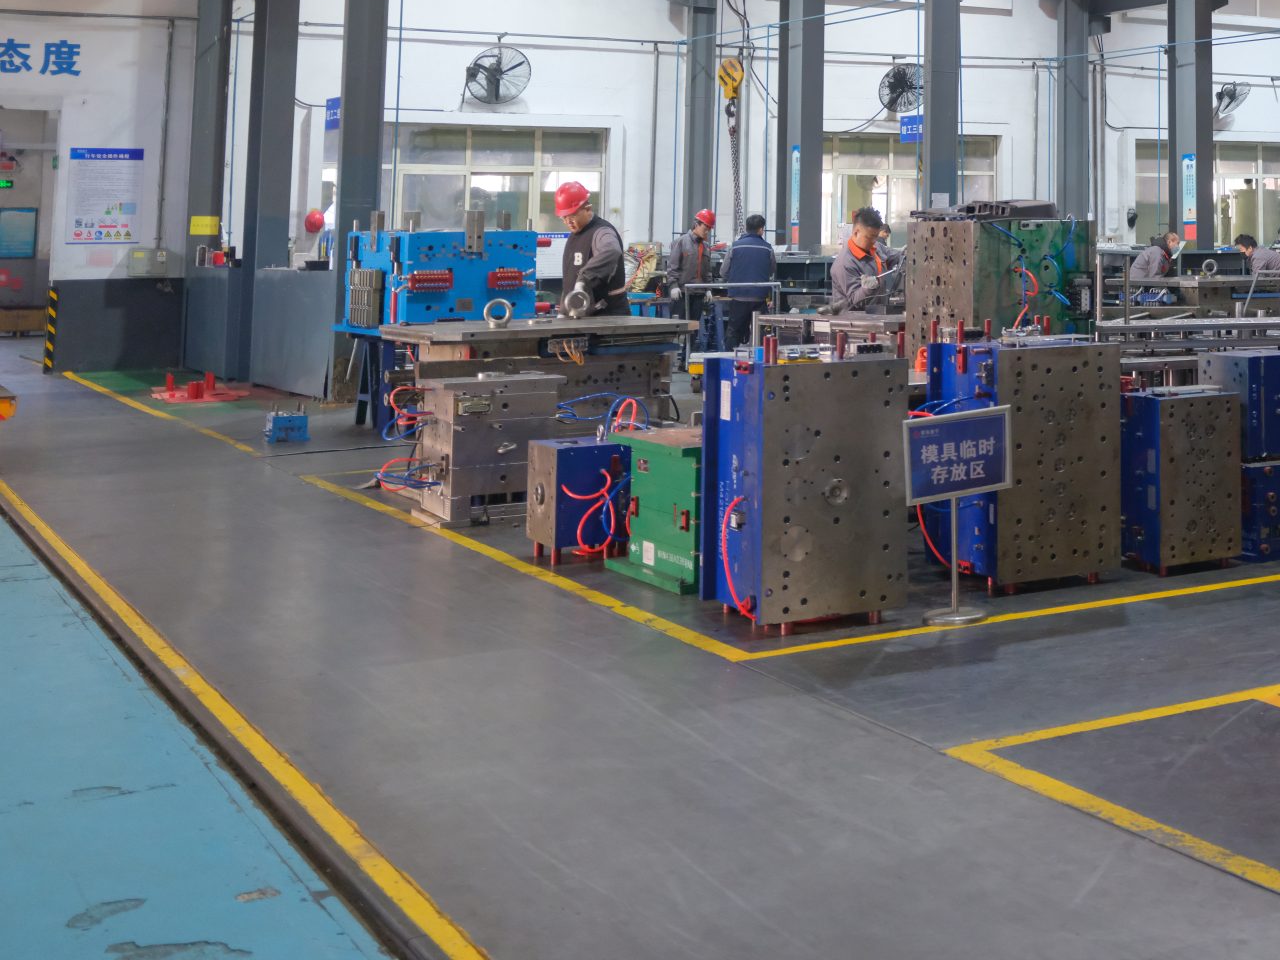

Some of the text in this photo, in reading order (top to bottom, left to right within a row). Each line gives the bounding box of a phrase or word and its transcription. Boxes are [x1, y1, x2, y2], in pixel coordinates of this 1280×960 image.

[0, 38, 82, 77] 态度
[574, 252, 583, 266] B
[920, 436, 996, 464] 模具临时
[930, 460, 987, 485] 存放区
